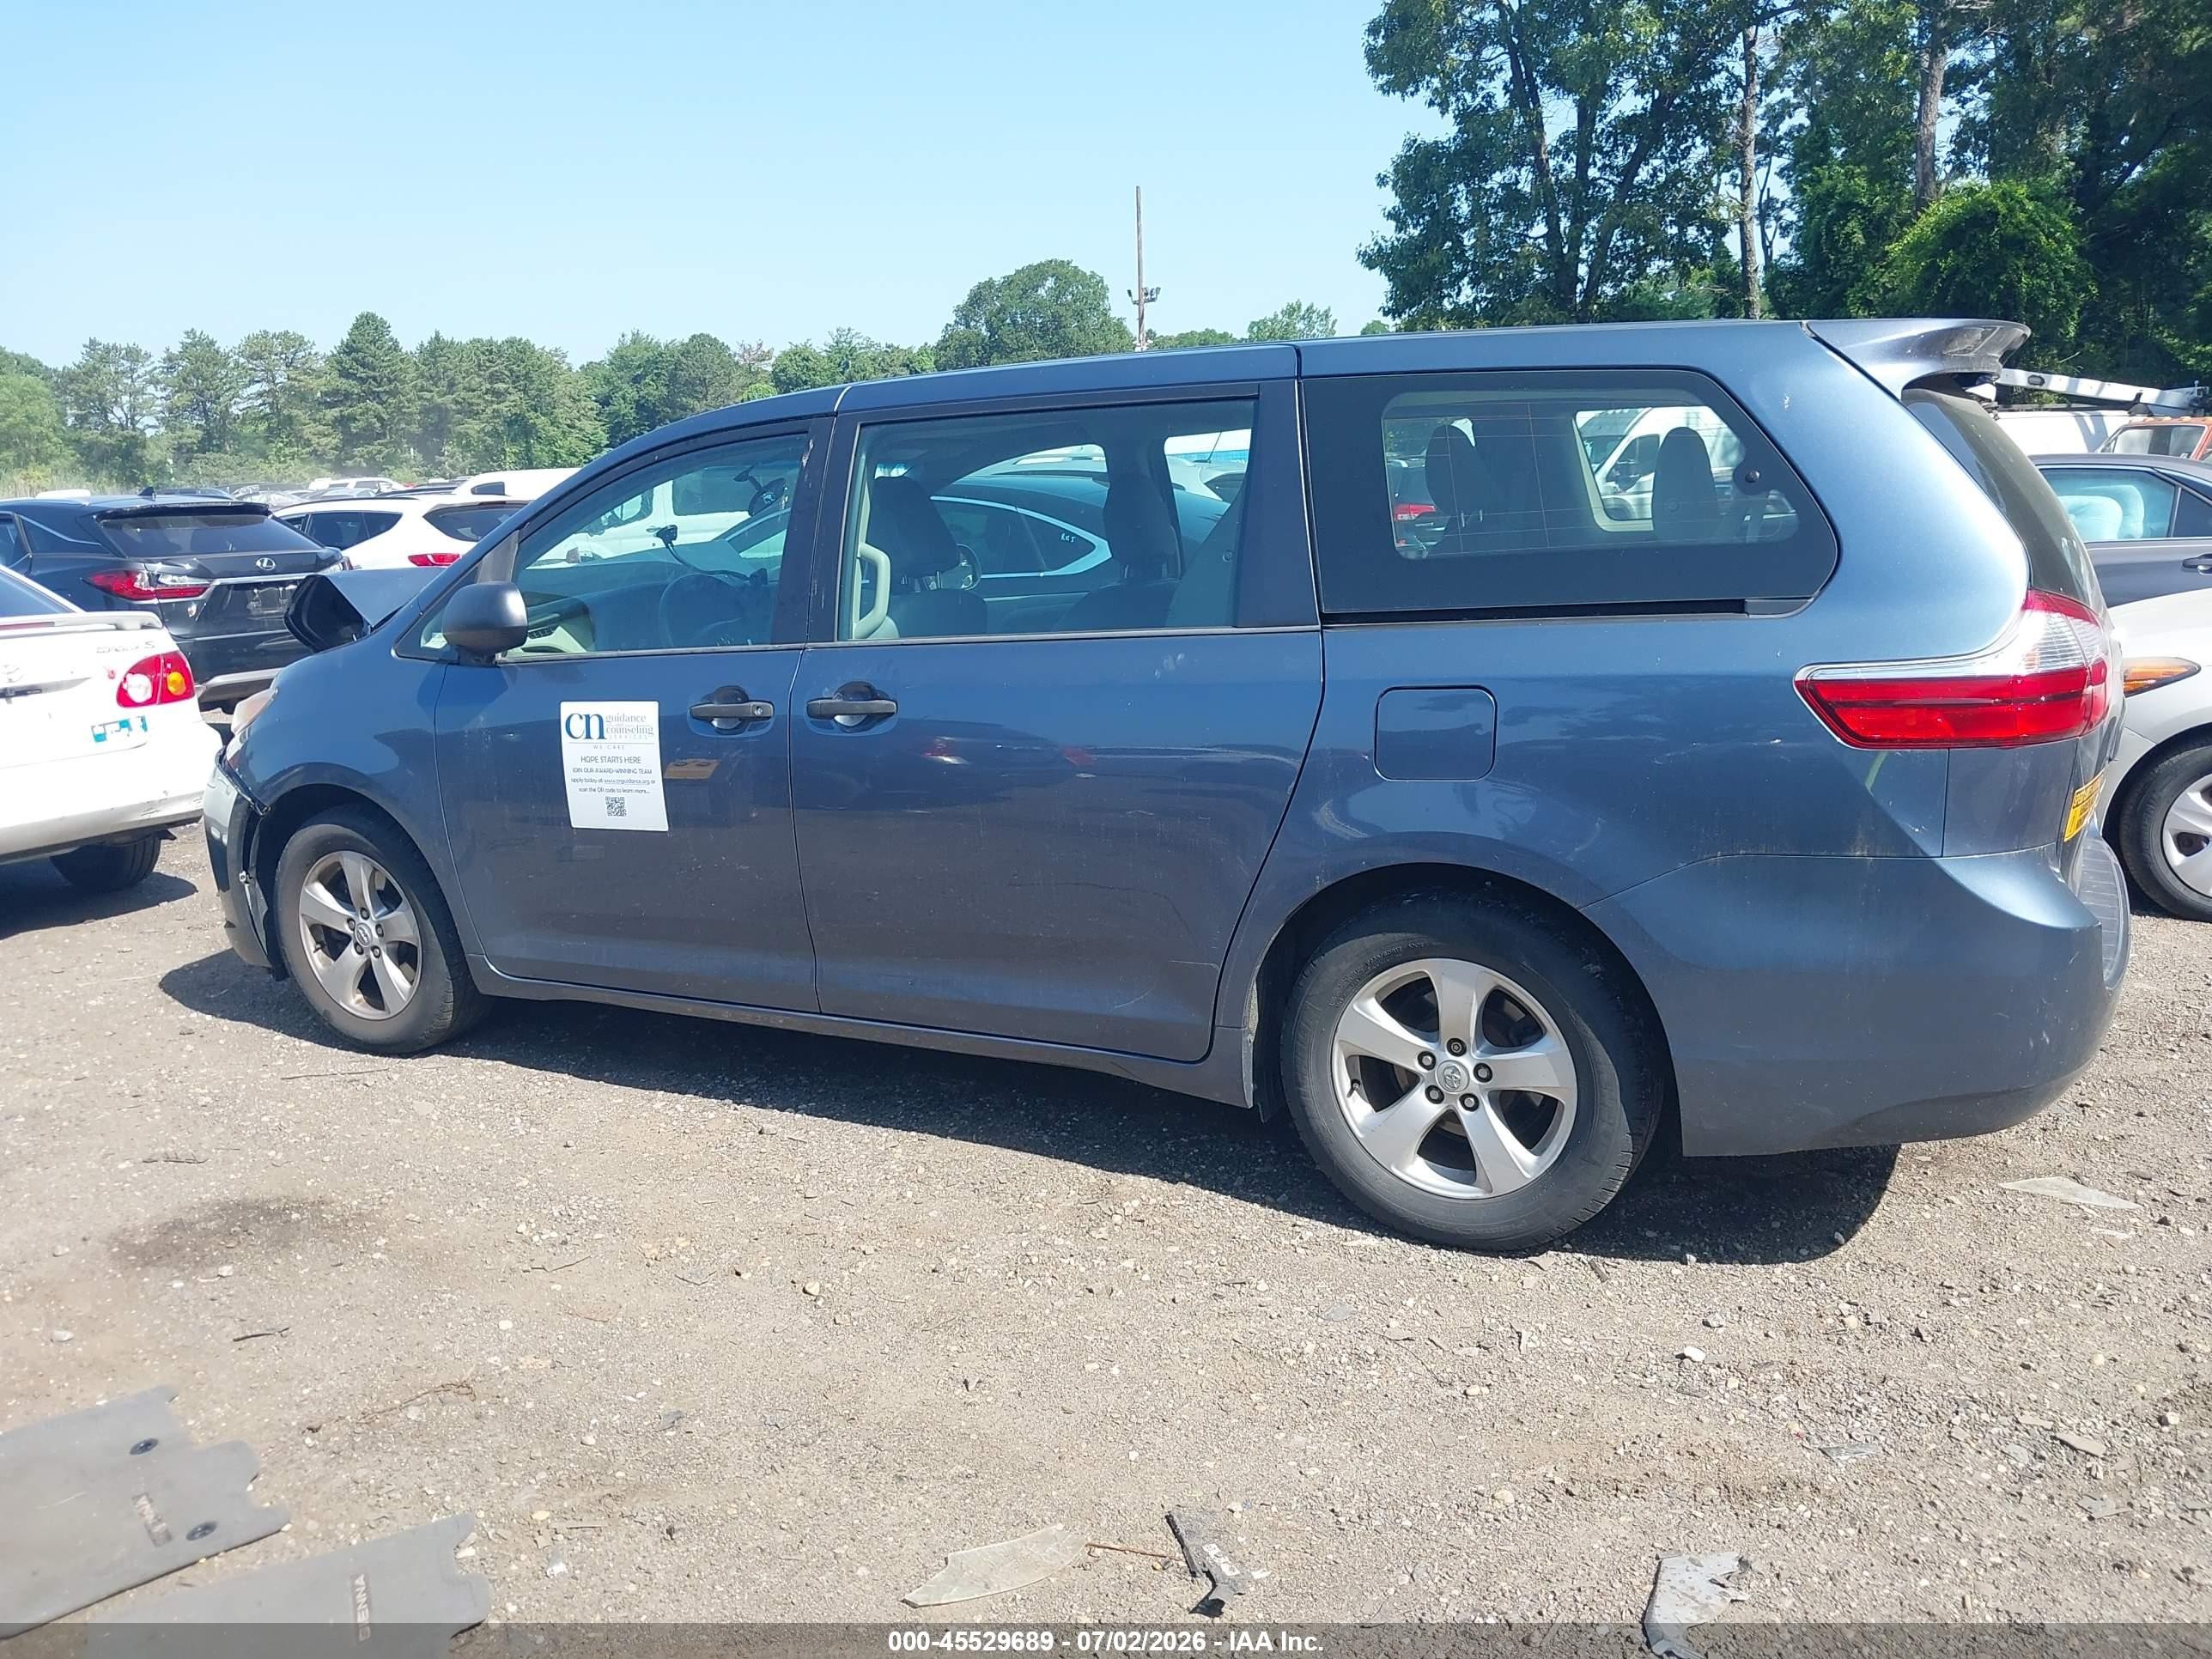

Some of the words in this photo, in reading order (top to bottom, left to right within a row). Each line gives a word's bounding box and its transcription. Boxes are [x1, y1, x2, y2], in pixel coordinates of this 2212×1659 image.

[605, 713, 646, 724] guidance
[565, 713, 606, 740] cn
[605, 725, 654, 736] counseling
[600, 756, 623, 764] STARTS
[624, 756, 642, 764] HERE
